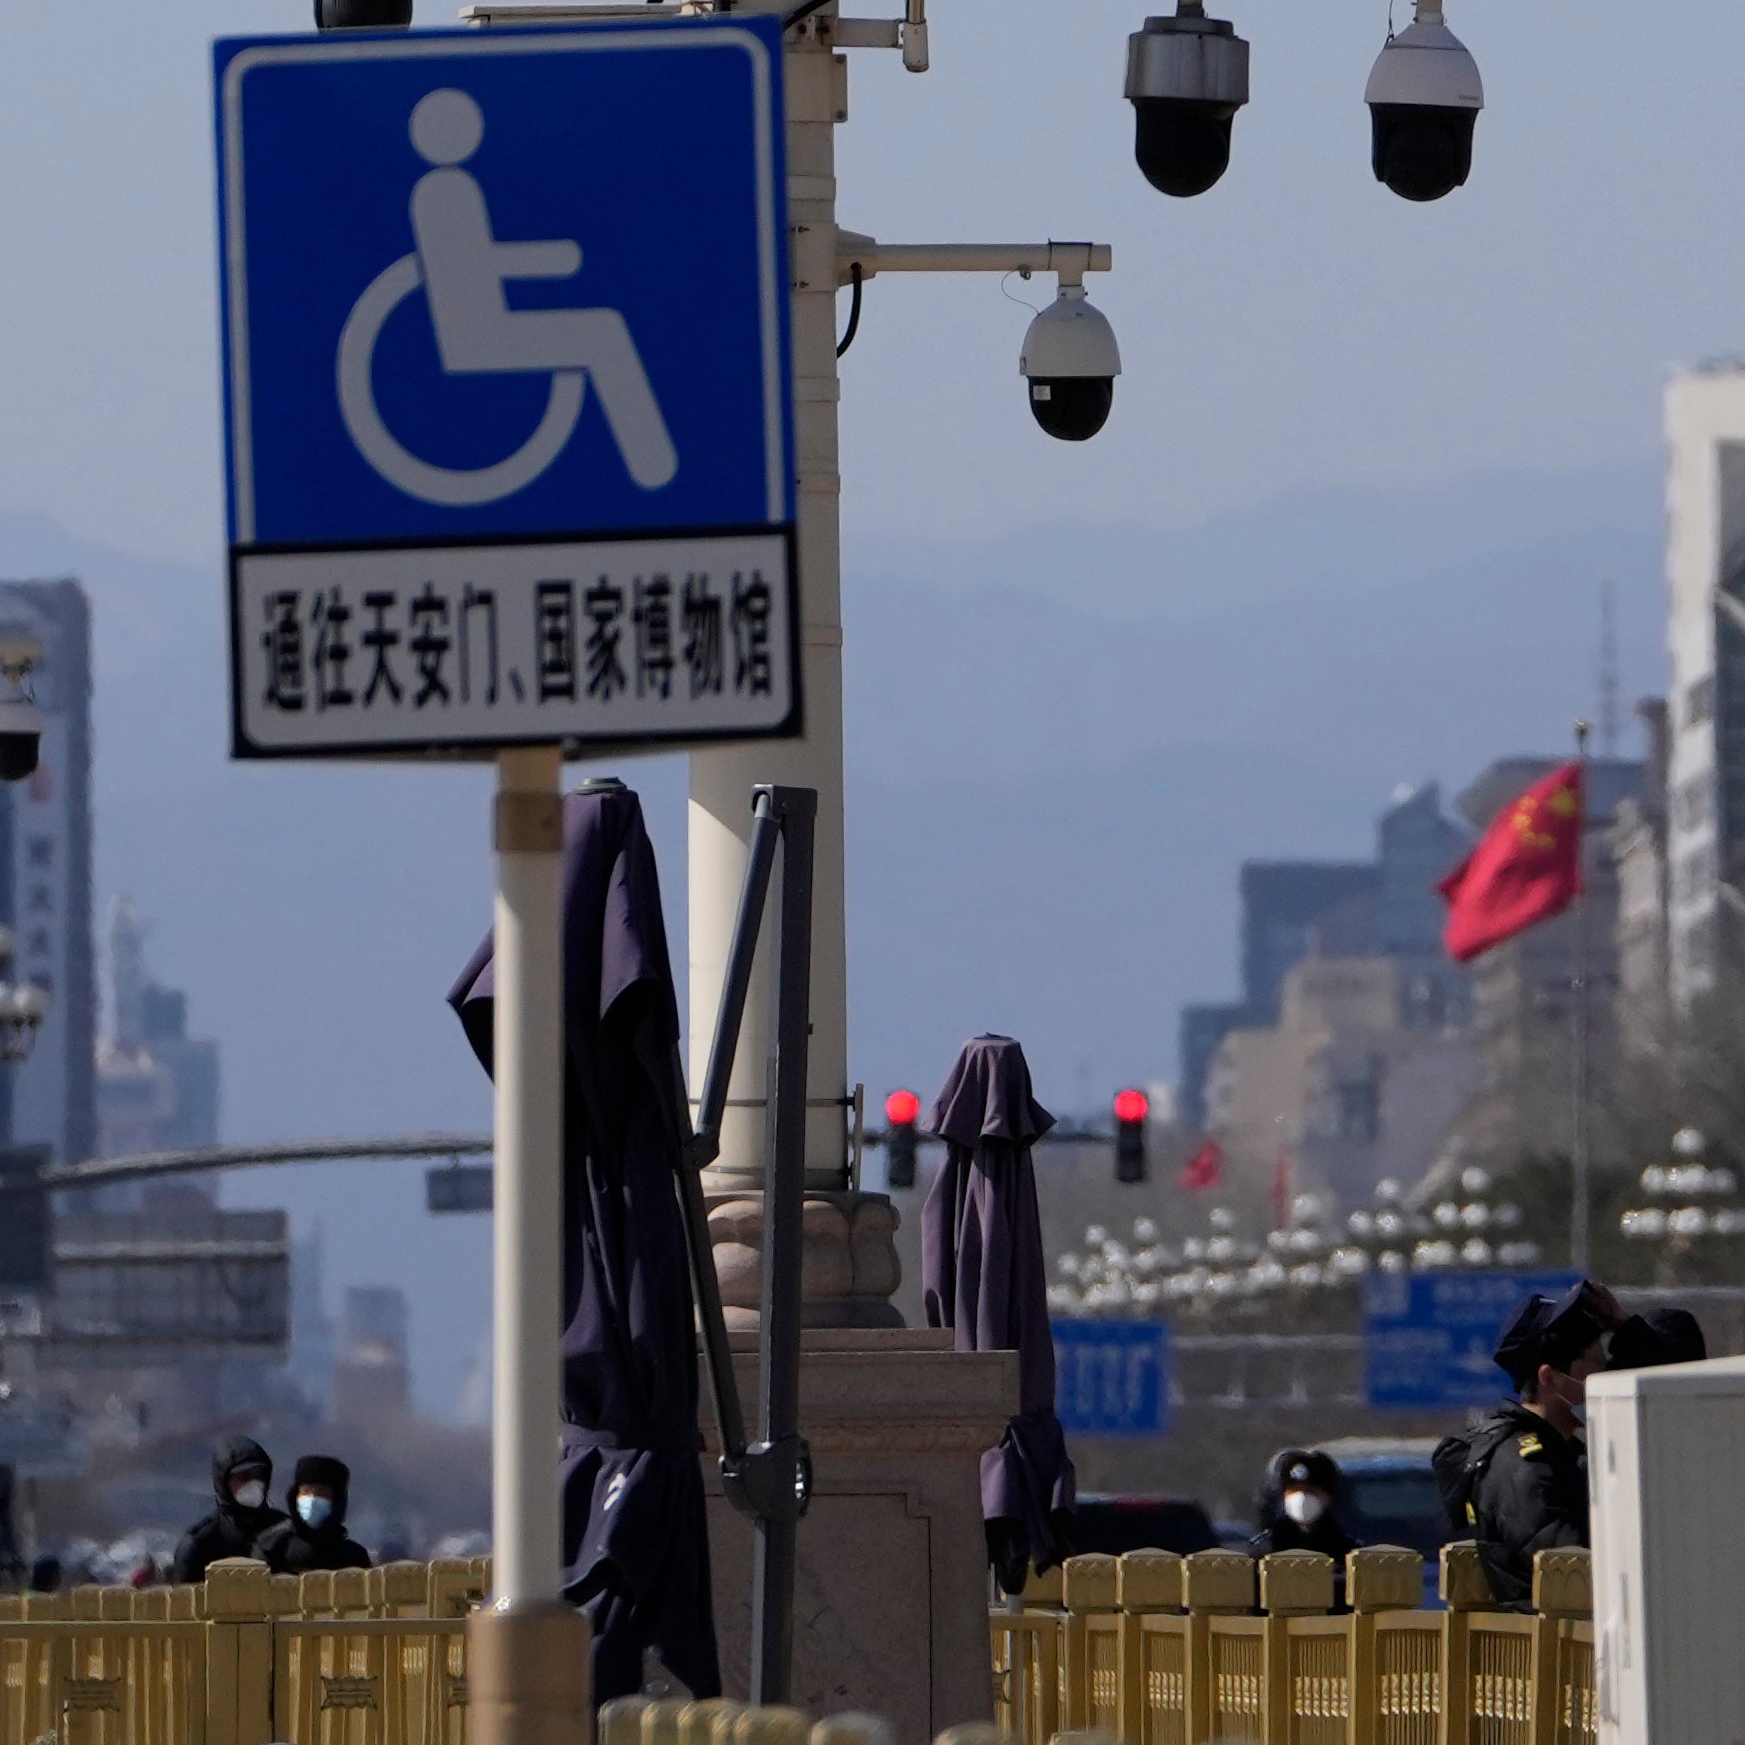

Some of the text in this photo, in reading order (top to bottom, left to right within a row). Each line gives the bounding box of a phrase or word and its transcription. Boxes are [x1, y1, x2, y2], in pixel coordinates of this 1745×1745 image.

[262, 568, 772, 711] 通往天安门、国家博物馆
